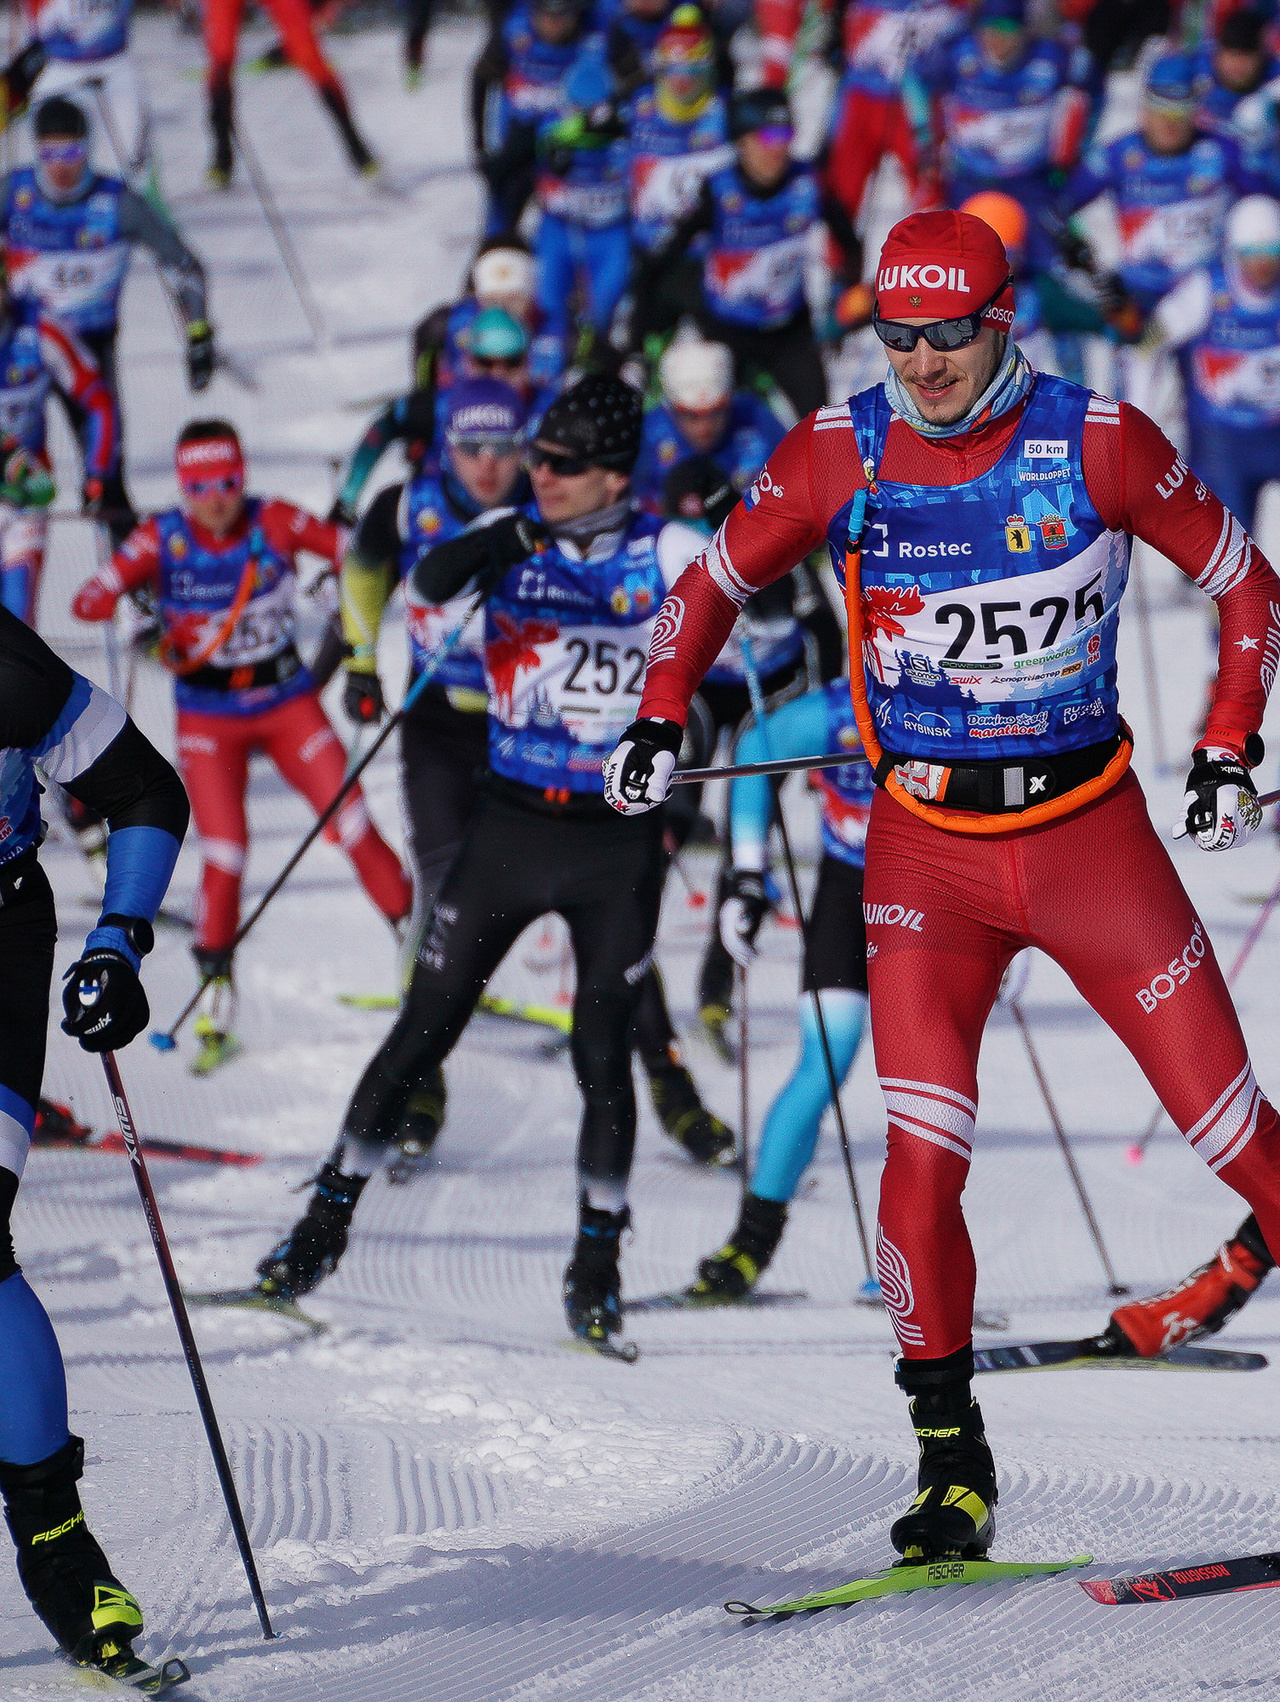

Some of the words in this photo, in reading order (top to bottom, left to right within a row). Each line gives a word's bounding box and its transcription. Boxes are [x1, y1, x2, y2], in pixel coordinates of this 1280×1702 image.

[878, 264, 971, 293] LUKOIL
[1028, 444, 1043, 455] 50
[1046, 443, 1064, 455] km
[1018, 467, 1071, 482] WORLDLOPPET
[898, 541, 973, 559] Rostec
[1013, 645, 1077, 669] greenworks
[1087, 651, 1101, 666] RM
[903, 720, 952, 738] RYBINSK
[1134, 932, 1206, 1014] BOSCO
[927, 1562, 966, 1582] FISCHER
[1167, 1563, 1232, 1585] ROSSIGNOL
